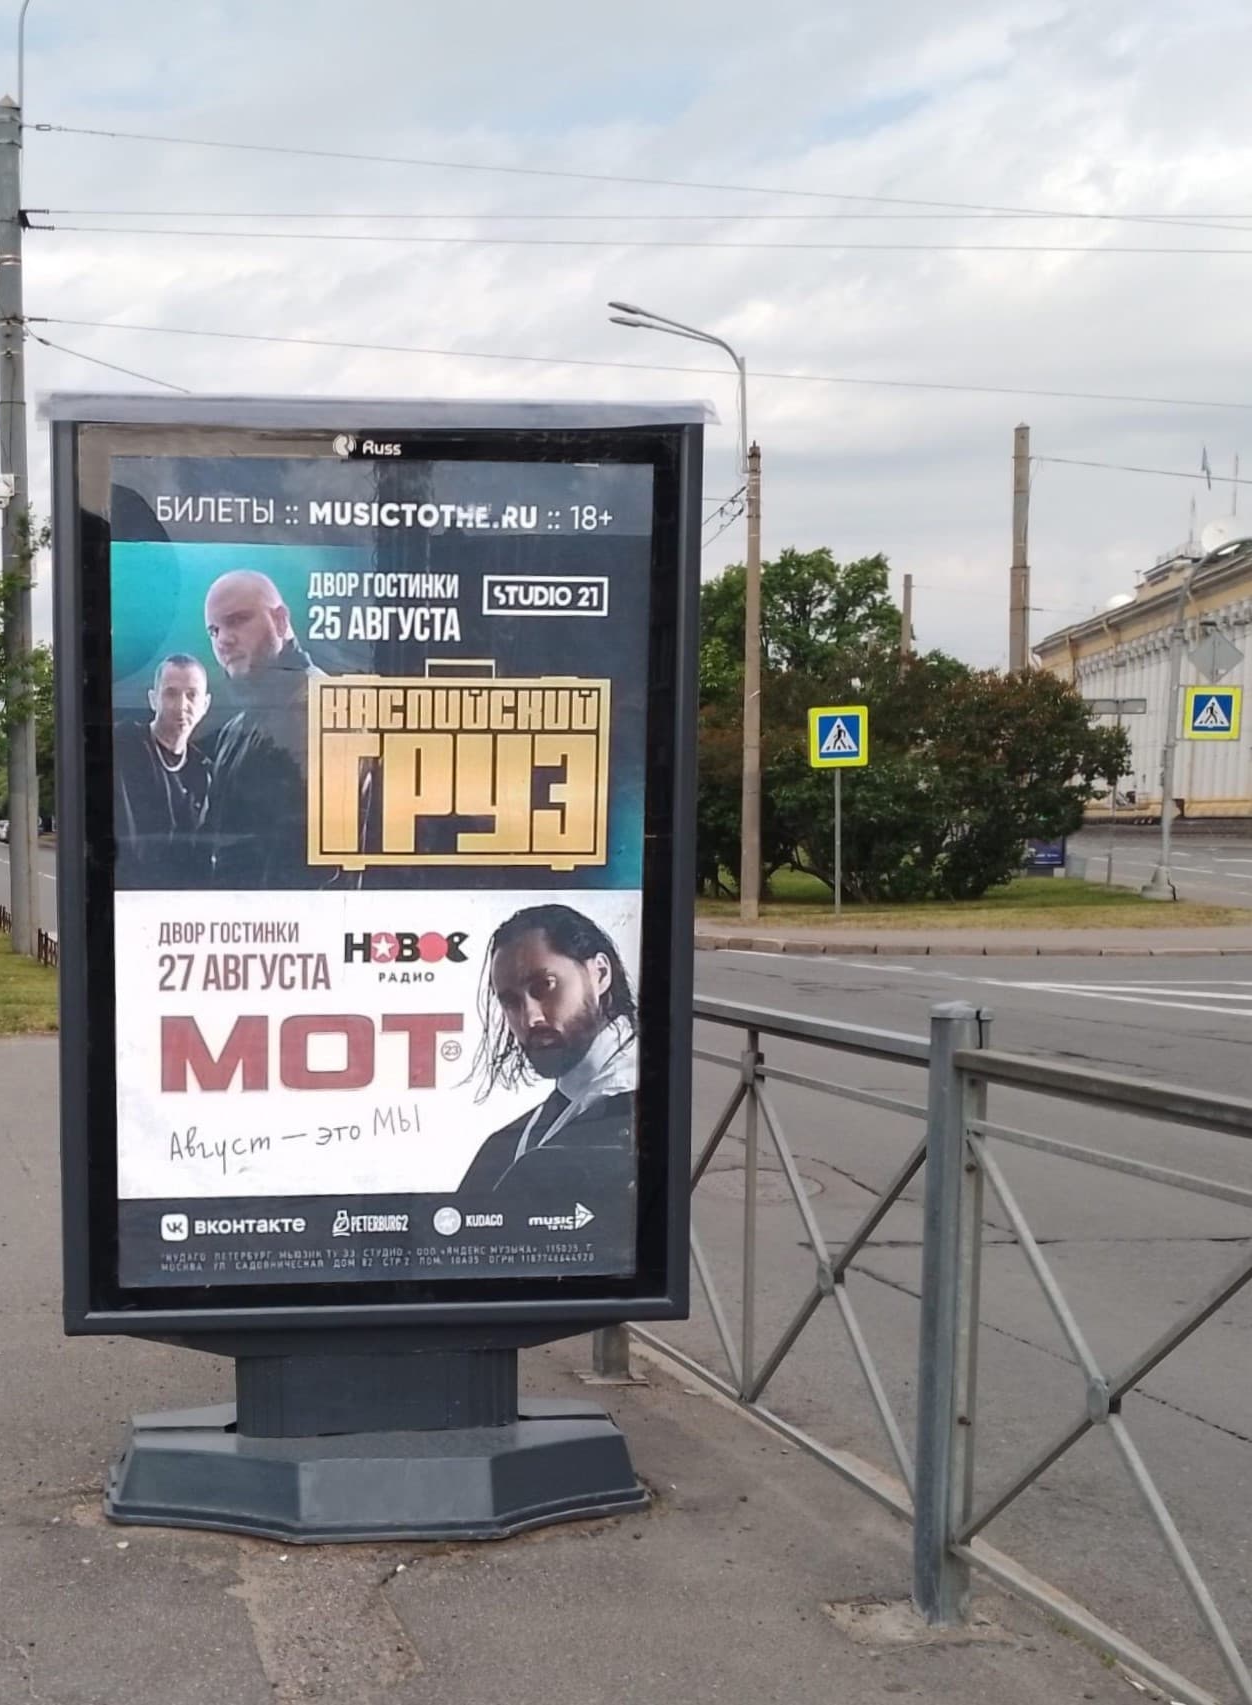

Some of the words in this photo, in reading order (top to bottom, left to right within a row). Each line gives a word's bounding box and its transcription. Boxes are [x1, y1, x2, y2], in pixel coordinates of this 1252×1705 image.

[361, 439, 402, 457] Russ
[156, 496, 275, 525] БИЛЕТЫ
[309, 502, 538, 529] MUSICTOTHE.RU
[570, 505, 613, 531] 18+
[307, 572, 360, 600] ДВОР
[363, 573, 459, 599] ГОСТИНКИ
[493, 585, 572, 606] STUDIO
[577, 586, 598, 607] 21
[308, 608, 342, 641] 25
[348, 607, 461, 642] АВГУСТА
[323, 688, 599, 729] КАСПИЙСКИЙ
[322, 733, 597, 854] ГРУЗ
[158, 923, 205, 946] ДВОР
[210, 922, 300, 944] ГОСТИНКИ
[158, 955, 194, 992] 27
[202, 953, 332, 992] АВГУСТА
[378, 971, 435, 984] РАДИО
[160, 1012, 464, 1093] МОТ
[169, 1126, 271, 1175] Август
[315, 1125, 361, 1146] это
[373, 1104, 421, 1137] МЫ
[465, 1214, 504, 1227] KUDAGO
